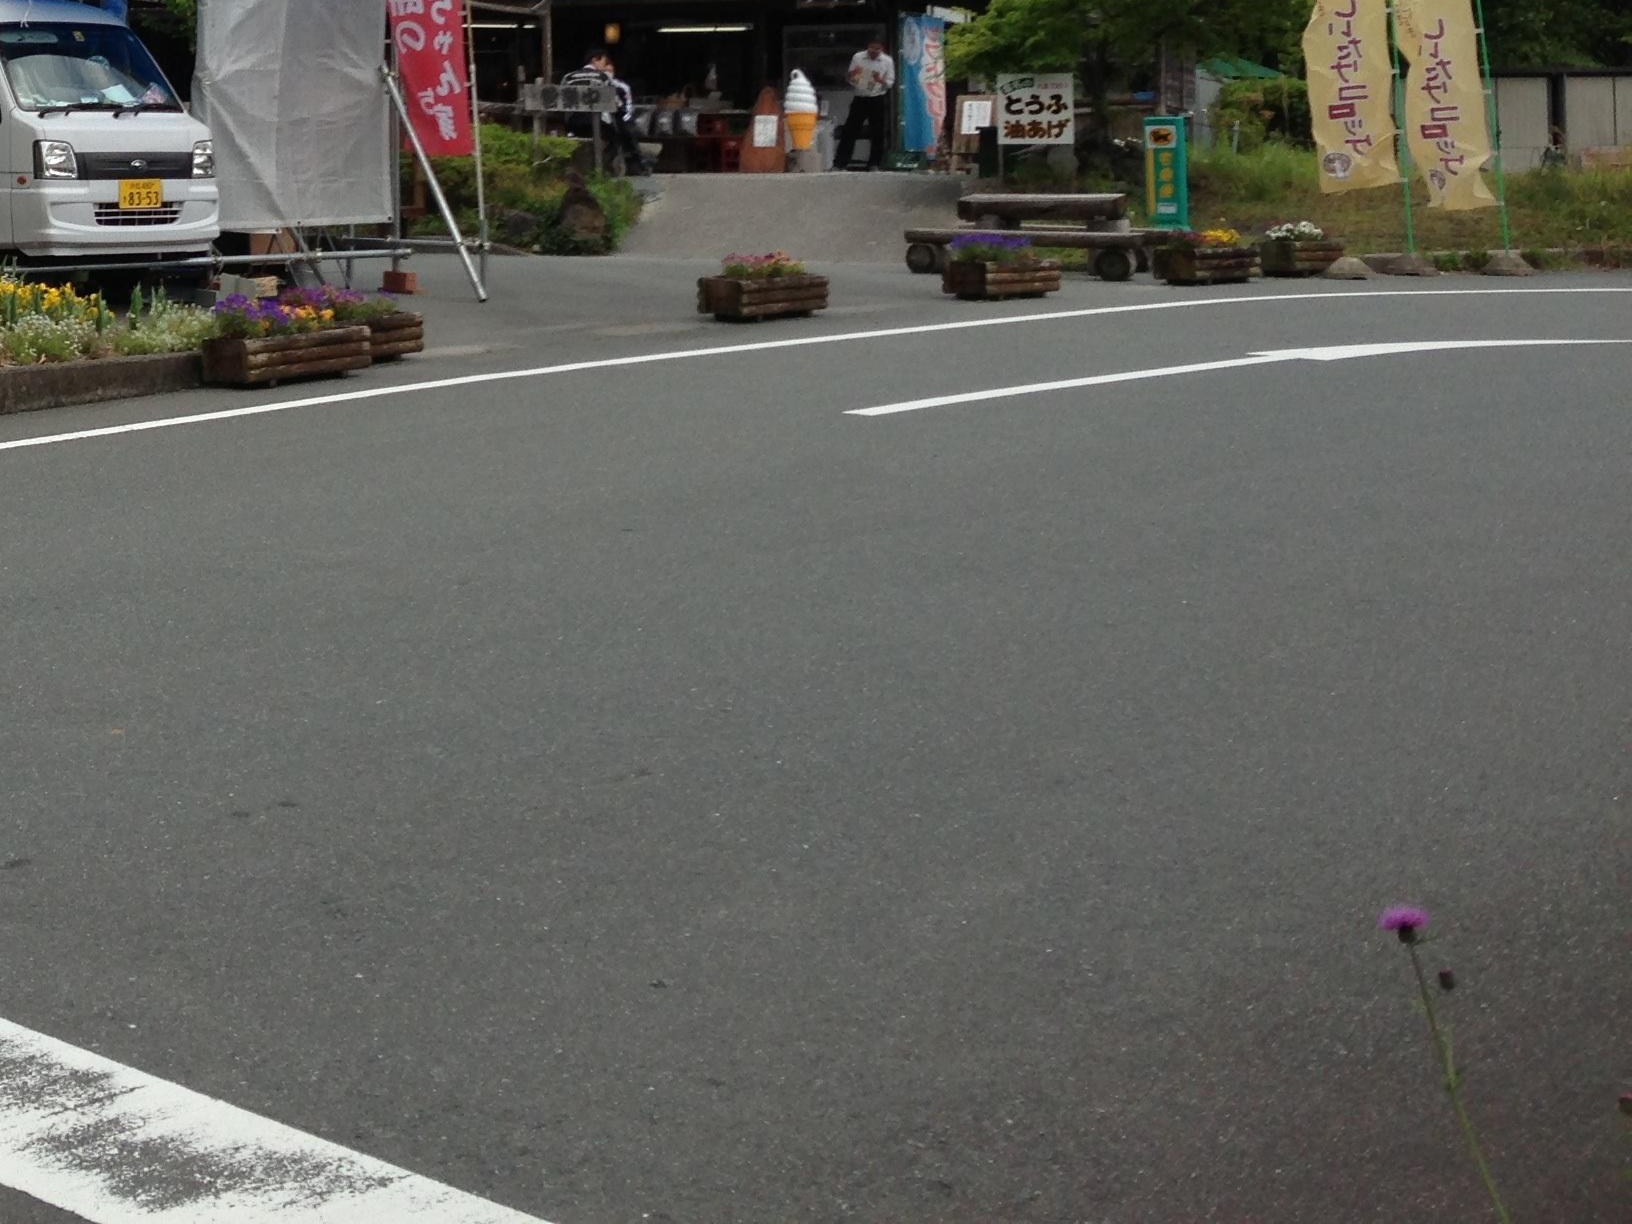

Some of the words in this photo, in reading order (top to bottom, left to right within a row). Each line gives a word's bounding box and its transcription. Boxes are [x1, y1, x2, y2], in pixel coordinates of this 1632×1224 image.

[1003, 93, 1068, 115] とうふ
[1003, 119, 1071, 139] 油あげ
[128, 191, 159, 206] 83-53
